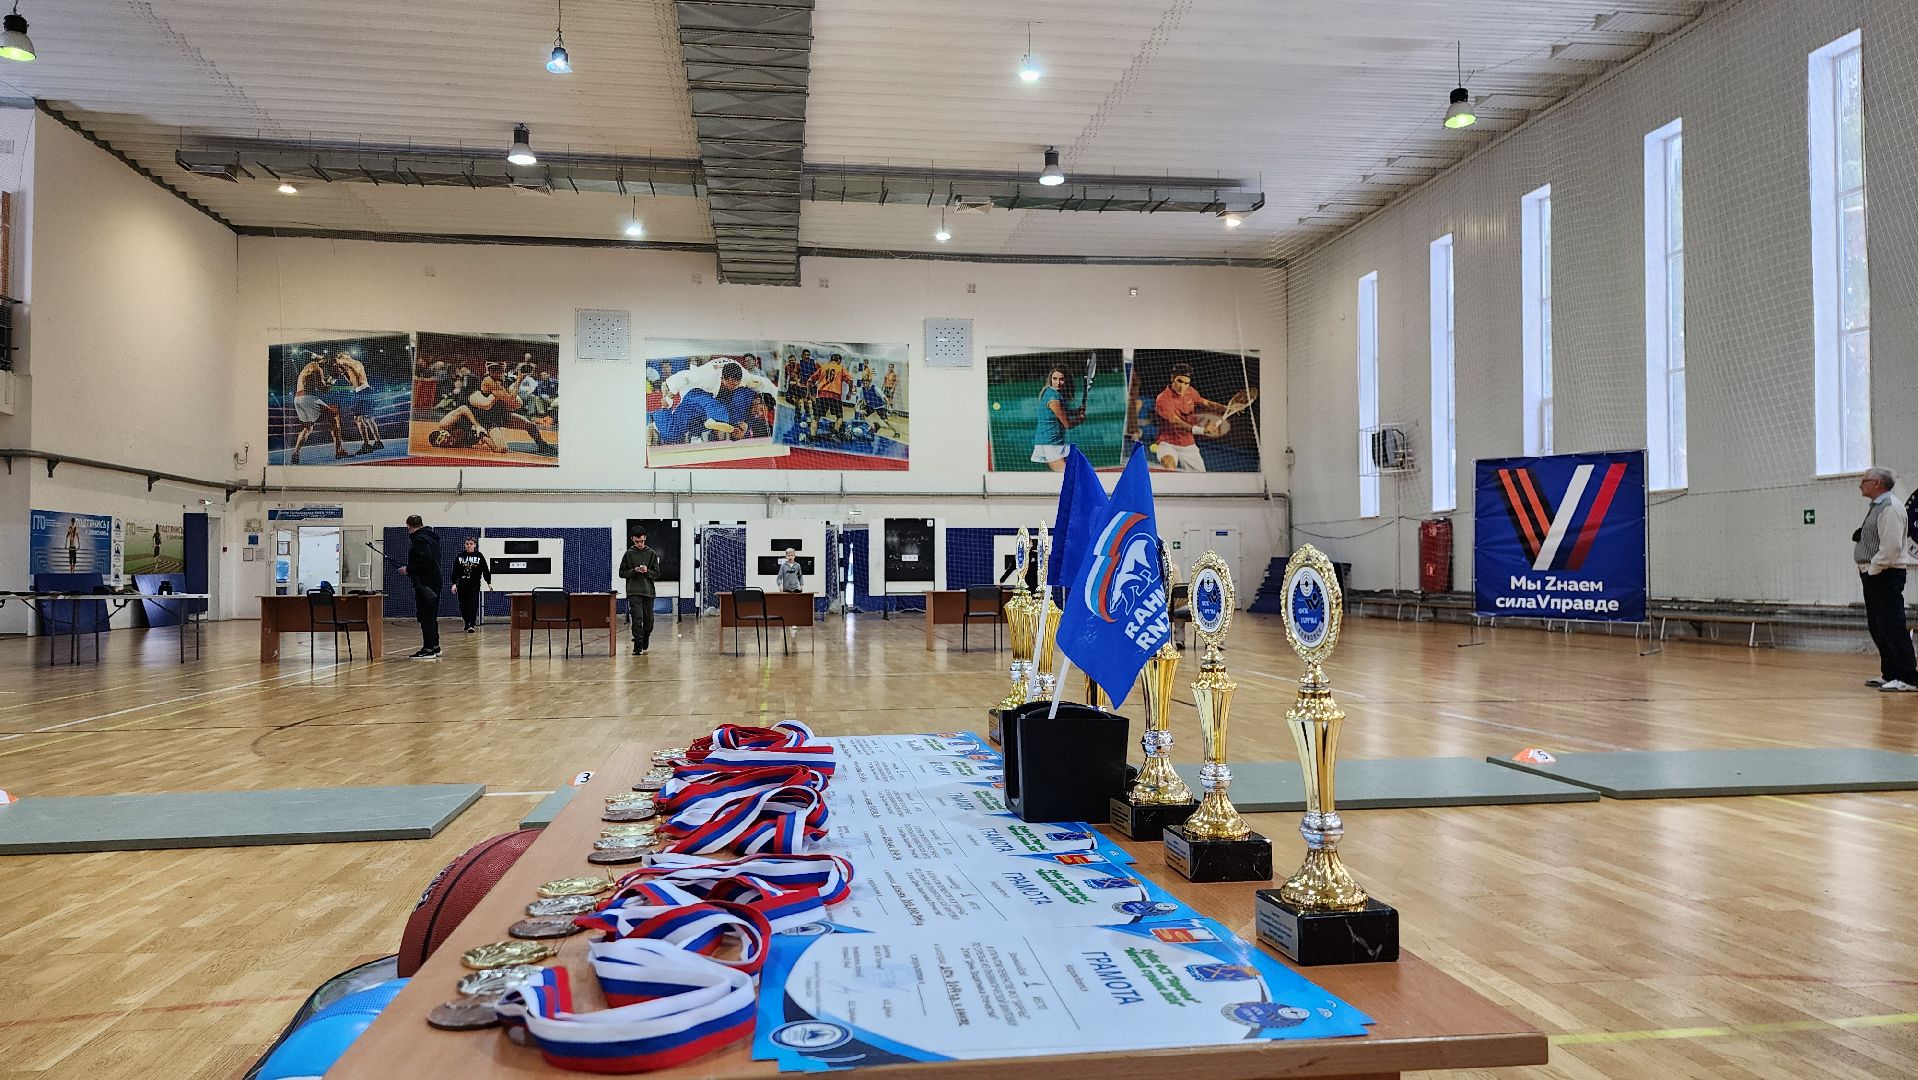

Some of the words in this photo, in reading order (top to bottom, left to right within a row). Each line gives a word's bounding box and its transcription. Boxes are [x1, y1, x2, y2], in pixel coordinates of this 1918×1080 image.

[1509, 576, 1541, 592] Мы
[1544, 575, 1604, 593] Zнаем
[1495, 594, 1620, 614] силаVправде
[580, 772, 591, 783] 3
[1002, 872, 1053, 905] ГРАМОТА
[1081, 951, 1144, 1006] ГРАМОТА
